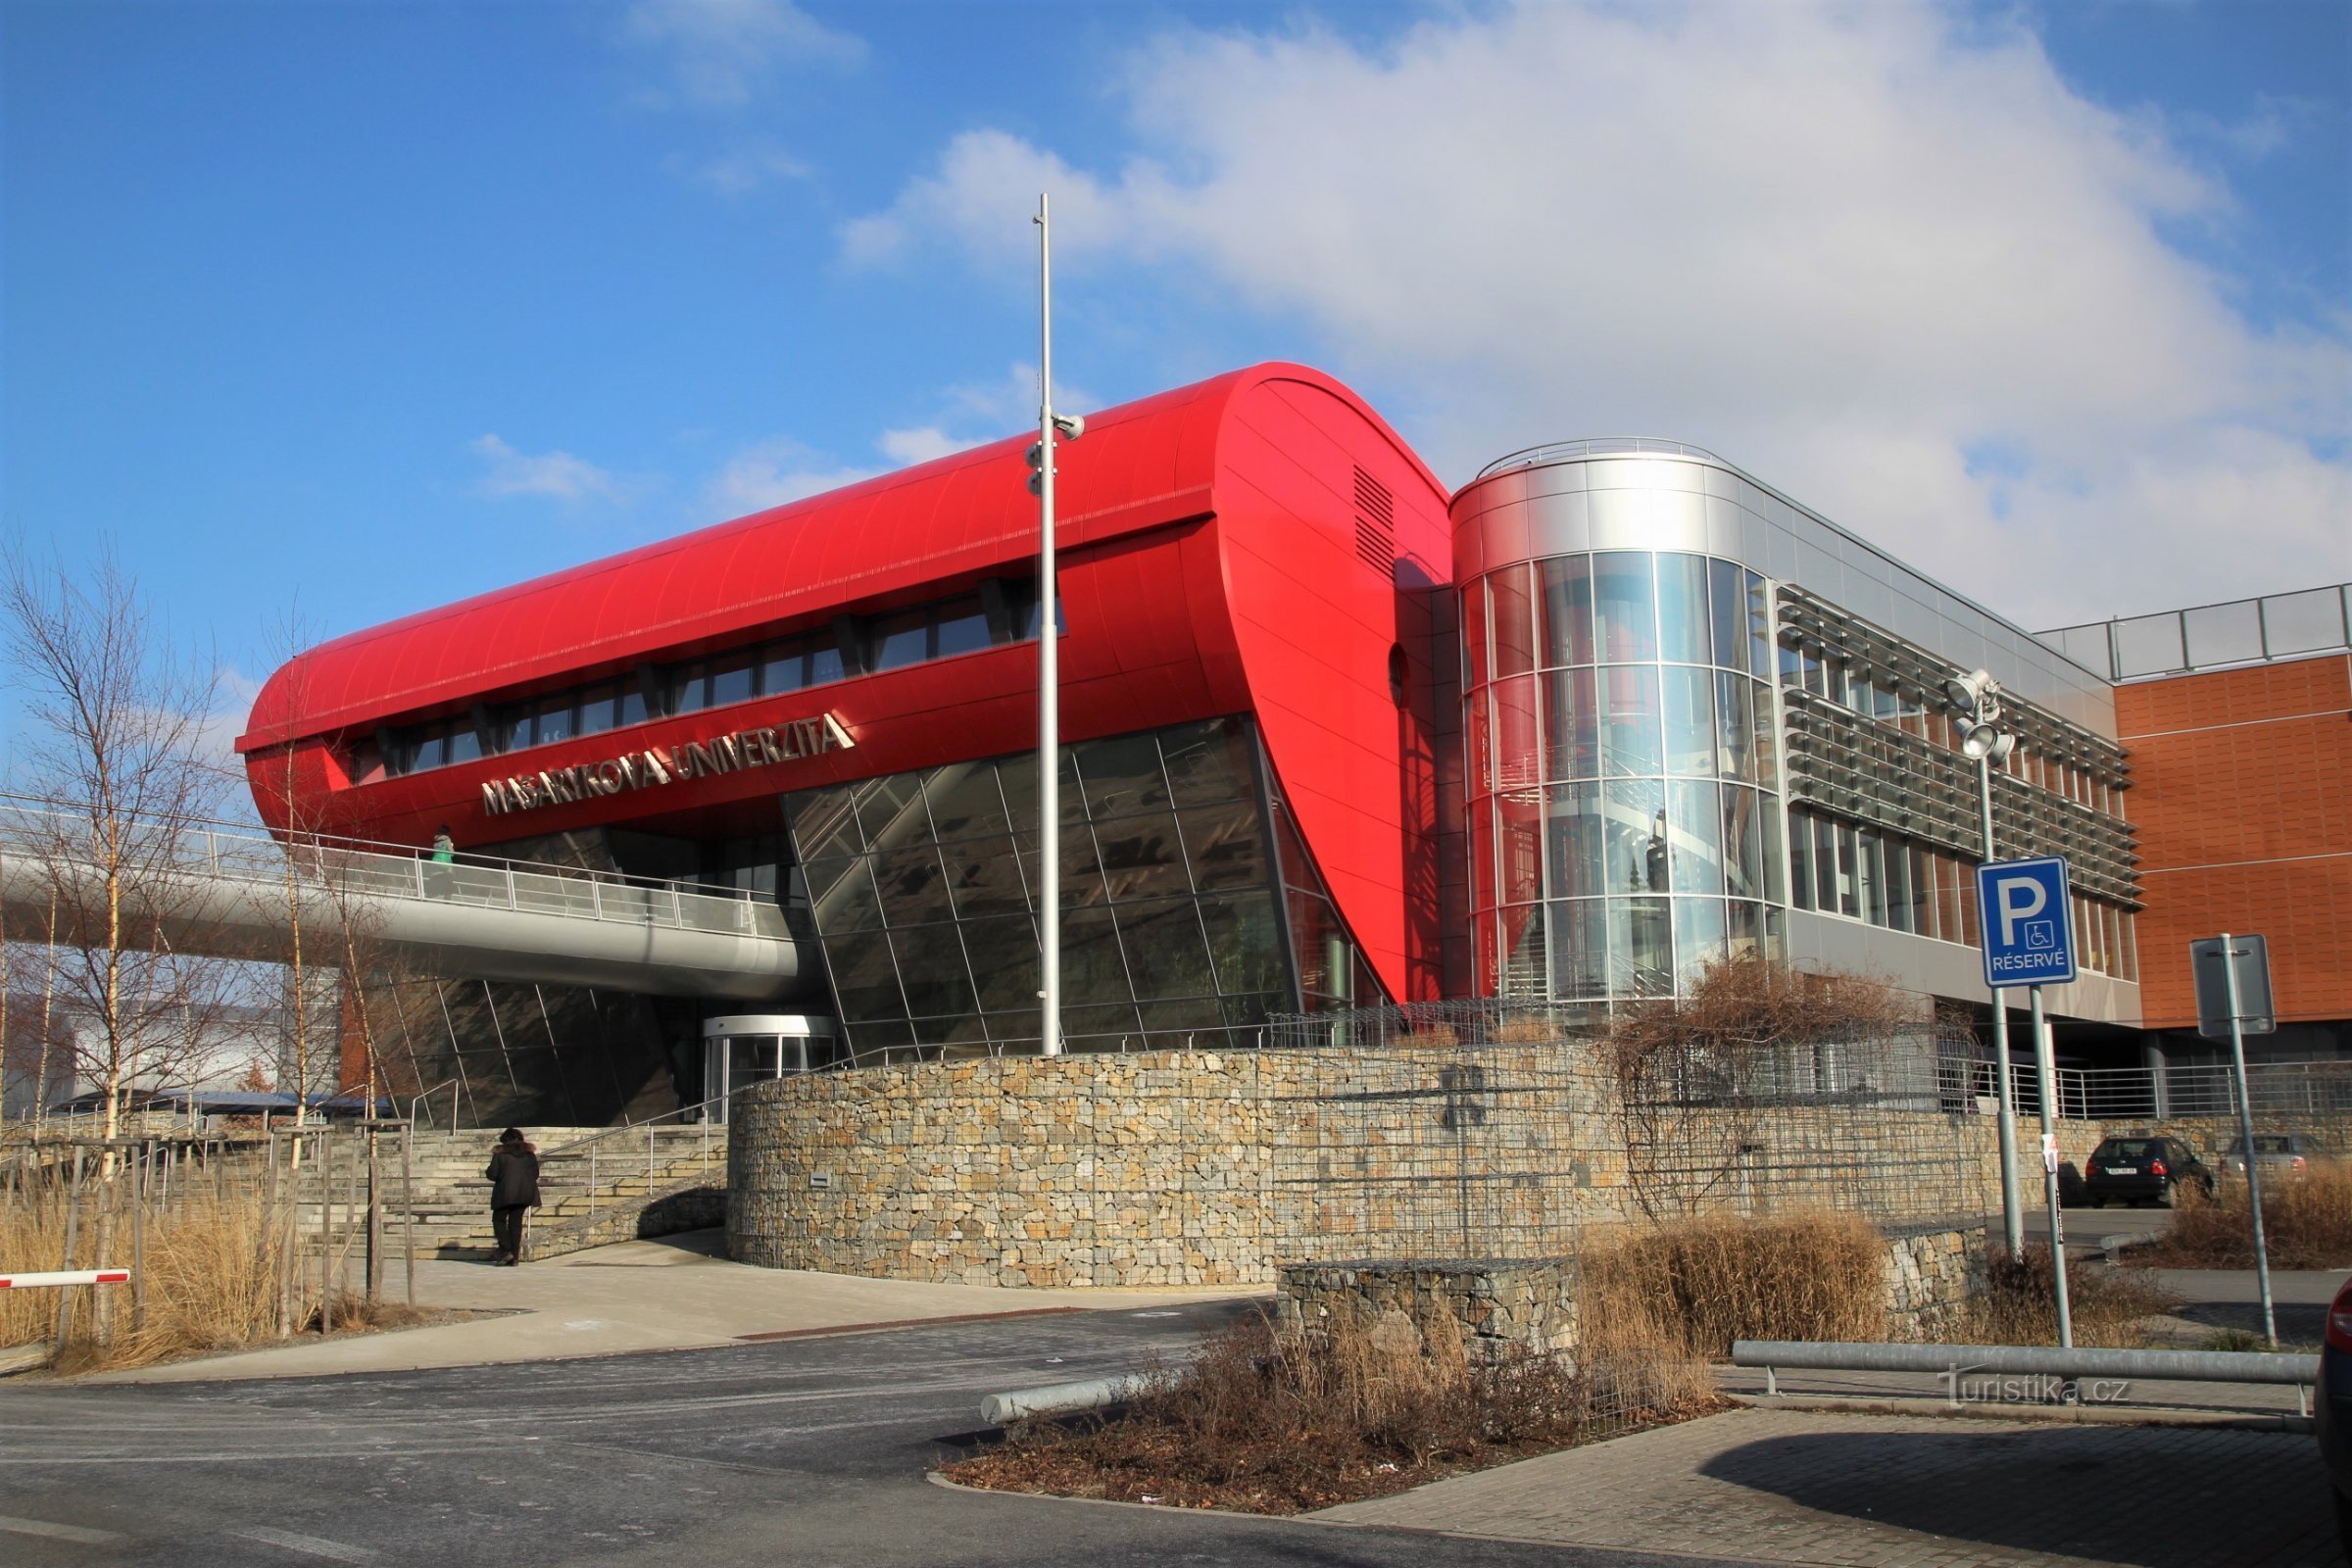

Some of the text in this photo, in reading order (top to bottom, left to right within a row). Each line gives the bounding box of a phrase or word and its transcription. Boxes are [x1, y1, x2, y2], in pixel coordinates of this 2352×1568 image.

[481, 712, 856, 815] MASARYKOVA UNIVERZITA
[1996, 876, 2047, 947] P
[1992, 948, 2066, 971] RÉSERVÉ
